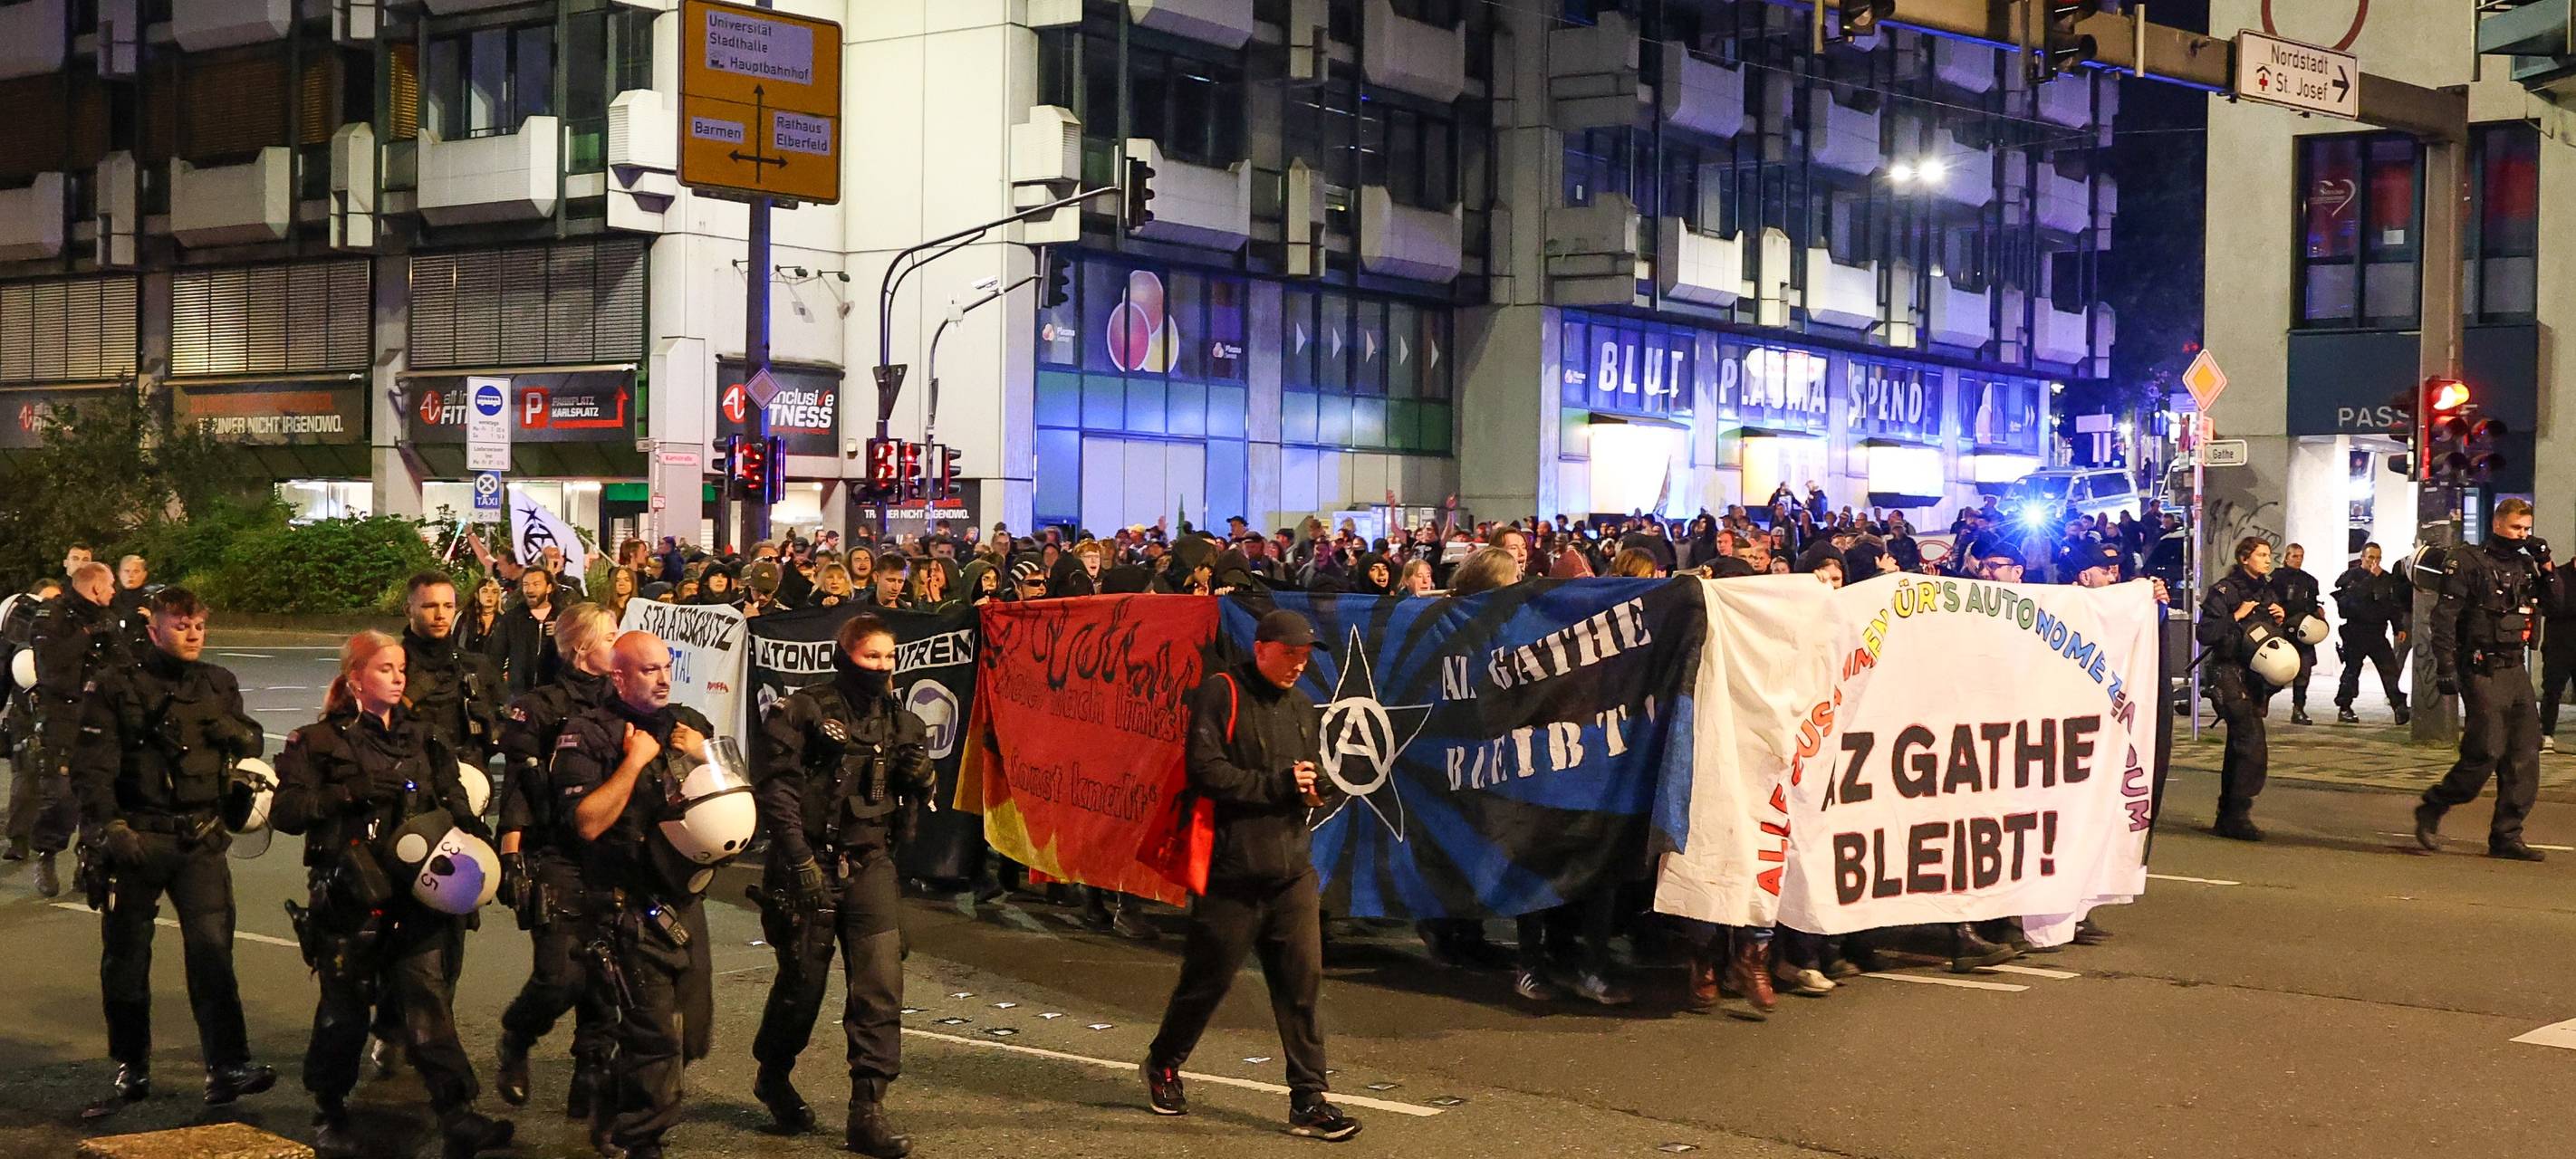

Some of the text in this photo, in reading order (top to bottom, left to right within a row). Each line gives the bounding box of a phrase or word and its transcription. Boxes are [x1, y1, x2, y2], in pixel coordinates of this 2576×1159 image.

[709, 14, 772, 37] Universität
[709, 32, 769, 53] Stadthalle
[730, 56, 809, 81] Hauptbahnhof
[2271, 43, 2329, 75] Nordstadt
[2275, 72, 2328, 101] St. Josef
[695, 121, 741, 139] Barmen
[776, 116, 822, 134] Rathaus
[776, 133, 828, 151] Elberfeld
[1599, 342, 1684, 398] BLUT
[525, 392, 543, 425] P
[552, 407, 600, 417] KARLSPLATZ
[769, 404, 833, 428] TNESS
[247, 416, 279, 434] NICHT
[283, 414, 344, 433] IRGENDWO.
[2213, 448, 2235, 460] Gathe
[476, 496, 498, 506] TAXI
[900, 509, 924, 519] NICHT
[1892, 578, 1960, 618] ÜR'S
[1965, 581, 2107, 685] AUTONOME
[1486, 596, 1652, 690] GATHE
[1892, 714, 2100, 798] GATHE
[441, 841, 460, 855] 3
[1833, 809, 2058, 905] BLEIBT!
[420, 873, 438, 890] 5
